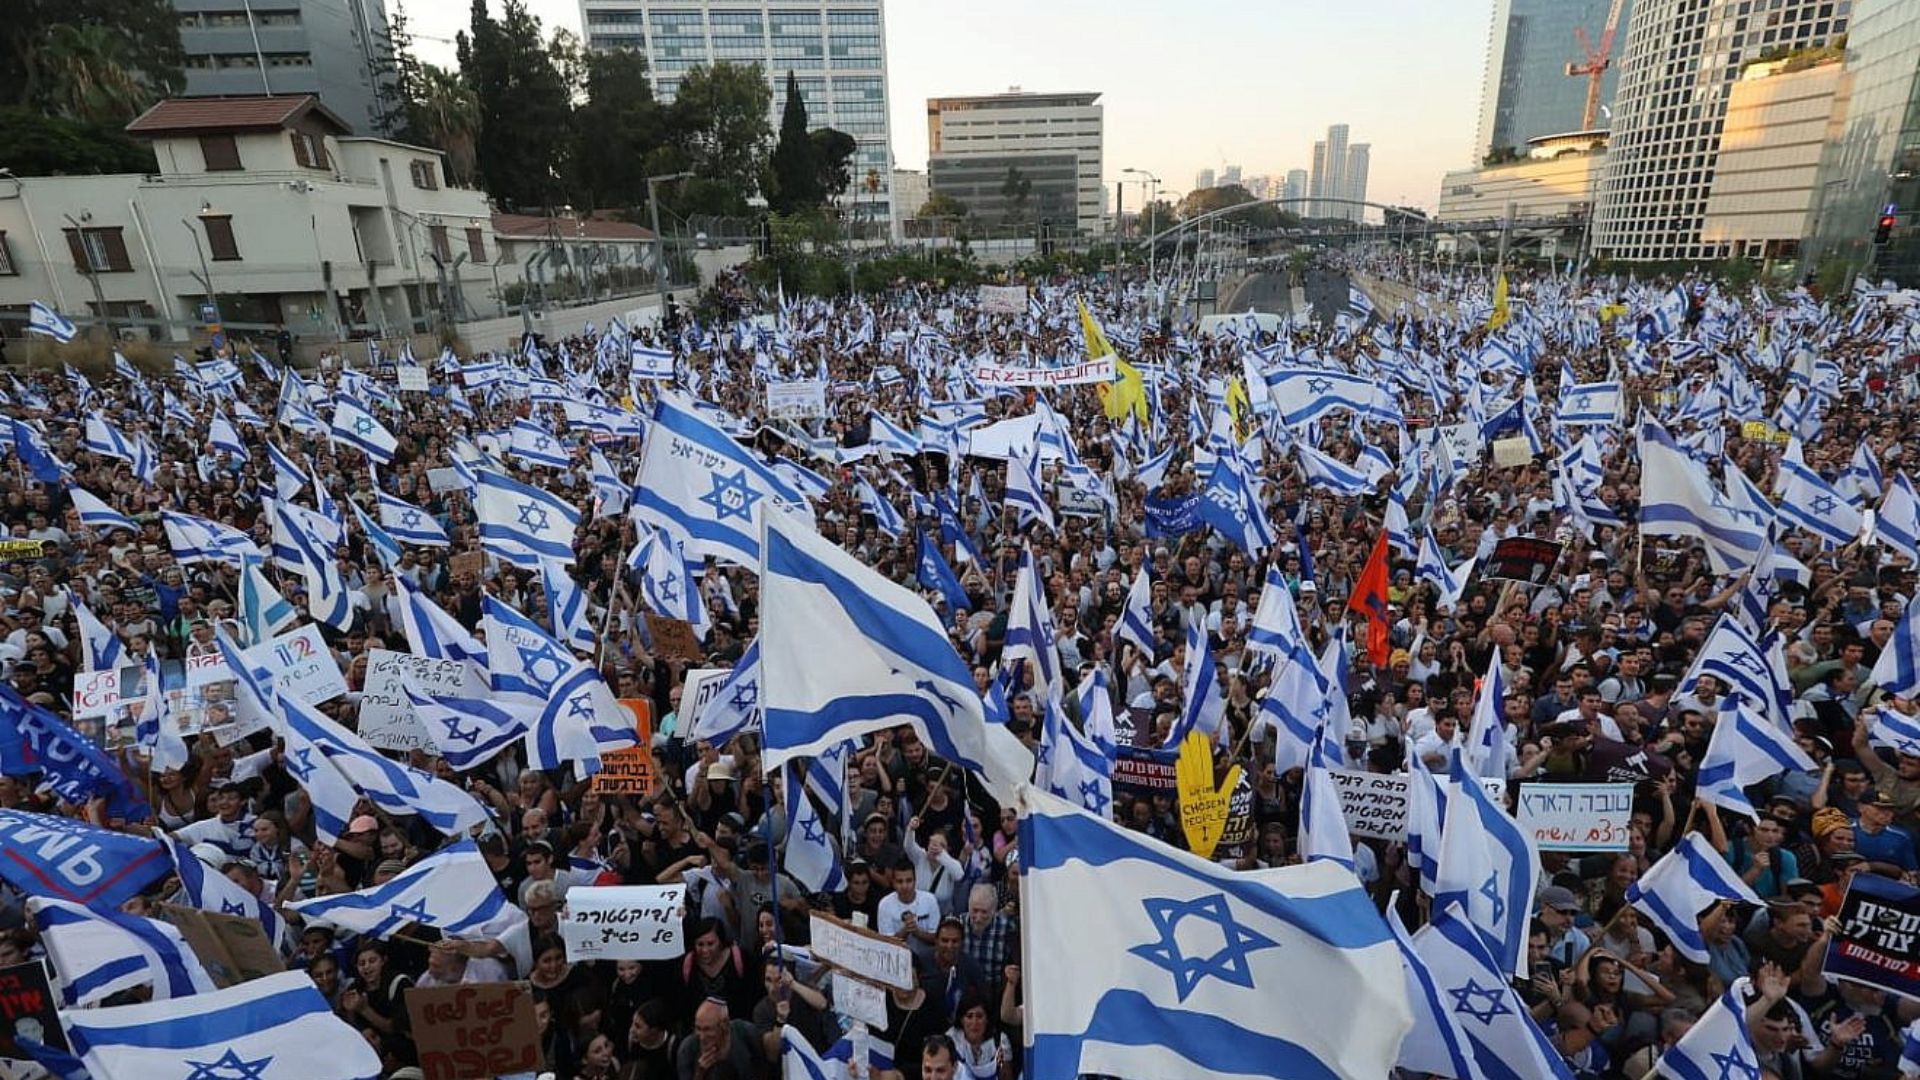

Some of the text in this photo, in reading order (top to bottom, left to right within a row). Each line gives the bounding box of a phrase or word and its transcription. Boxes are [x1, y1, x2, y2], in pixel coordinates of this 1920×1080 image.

[671, 438, 726, 468] ישראל
[727, 490, 742, 506] חי
[274, 636, 316, 667] 12
[1371, 780, 1407, 792] העם
[1183, 797, 1225, 815] CHOSEN
[1342, 791, 1406, 806] רפורמה
[1522, 794, 1630, 817] טובה הארץ
[1342, 805, 1406, 820] משפטית
[1355, 820, 1404, 834] מלאה
[1535, 827, 1576, 842] משיח
[660, 891, 678, 901] די
[576, 906, 675, 925] לדיקטטורה
[651, 929, 673, 943] של
